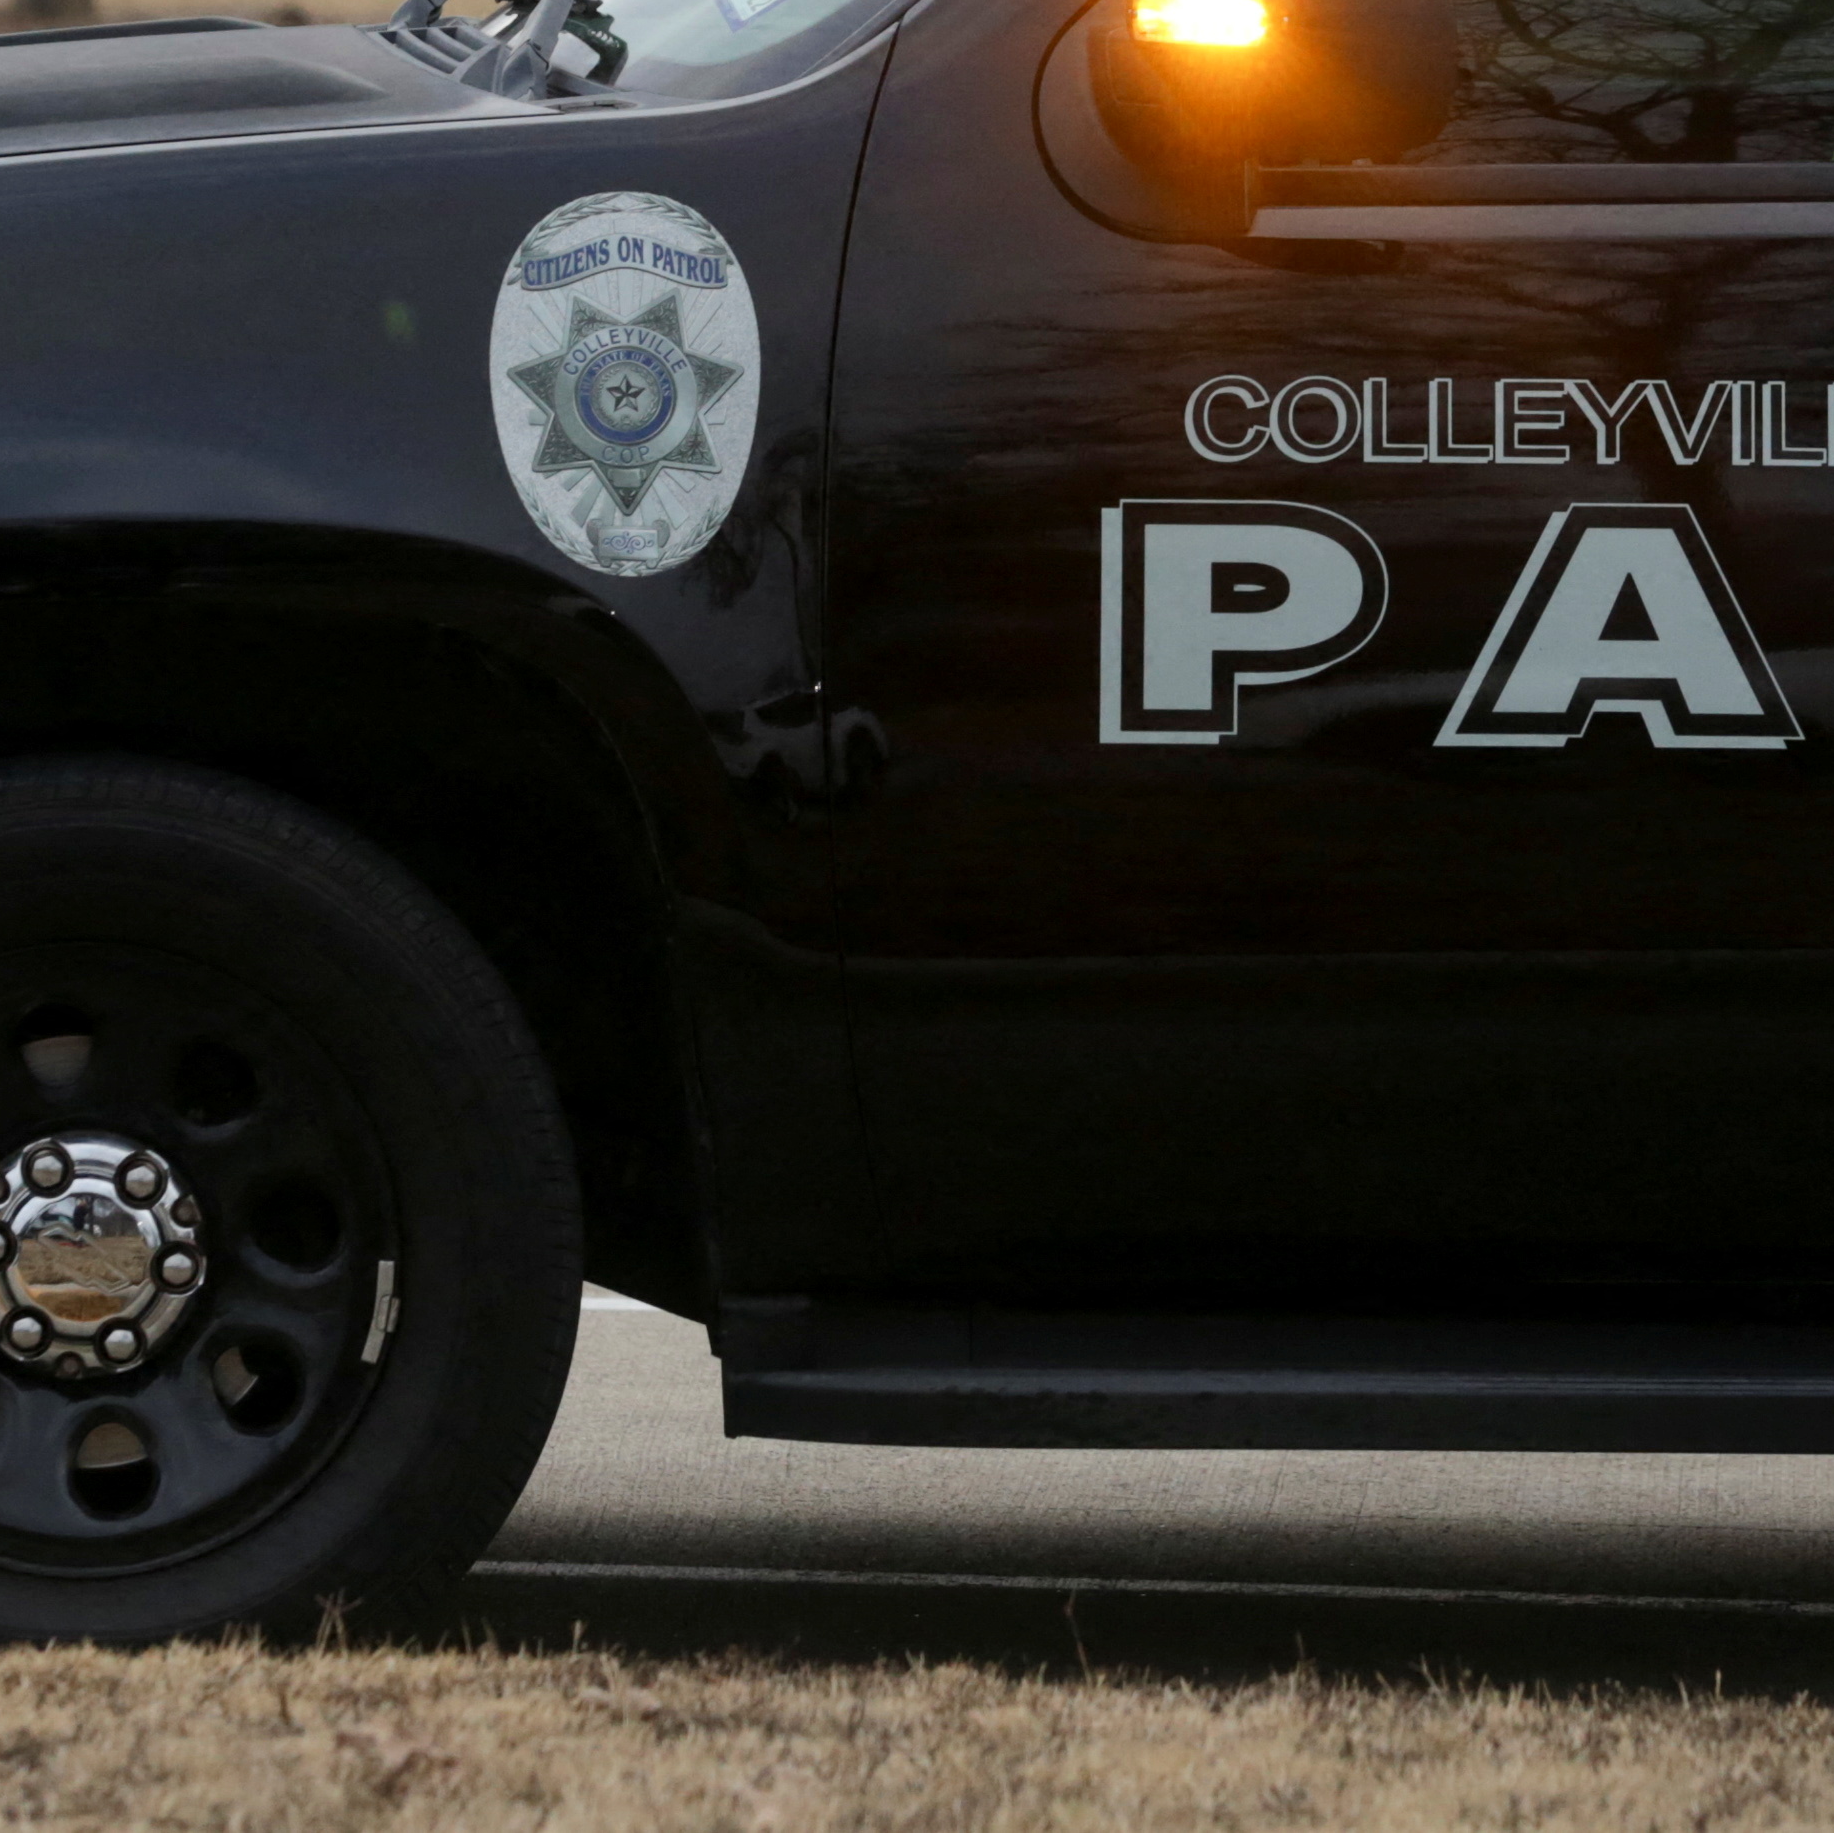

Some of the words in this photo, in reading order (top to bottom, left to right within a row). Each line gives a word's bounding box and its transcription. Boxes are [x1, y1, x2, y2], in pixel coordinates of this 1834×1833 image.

[523, 239, 610, 286] CITIZENS
[616, 236, 644, 264] ON
[651, 241, 725, 284] PATROL
[563, 328, 688, 376] COLLEYVILLE
